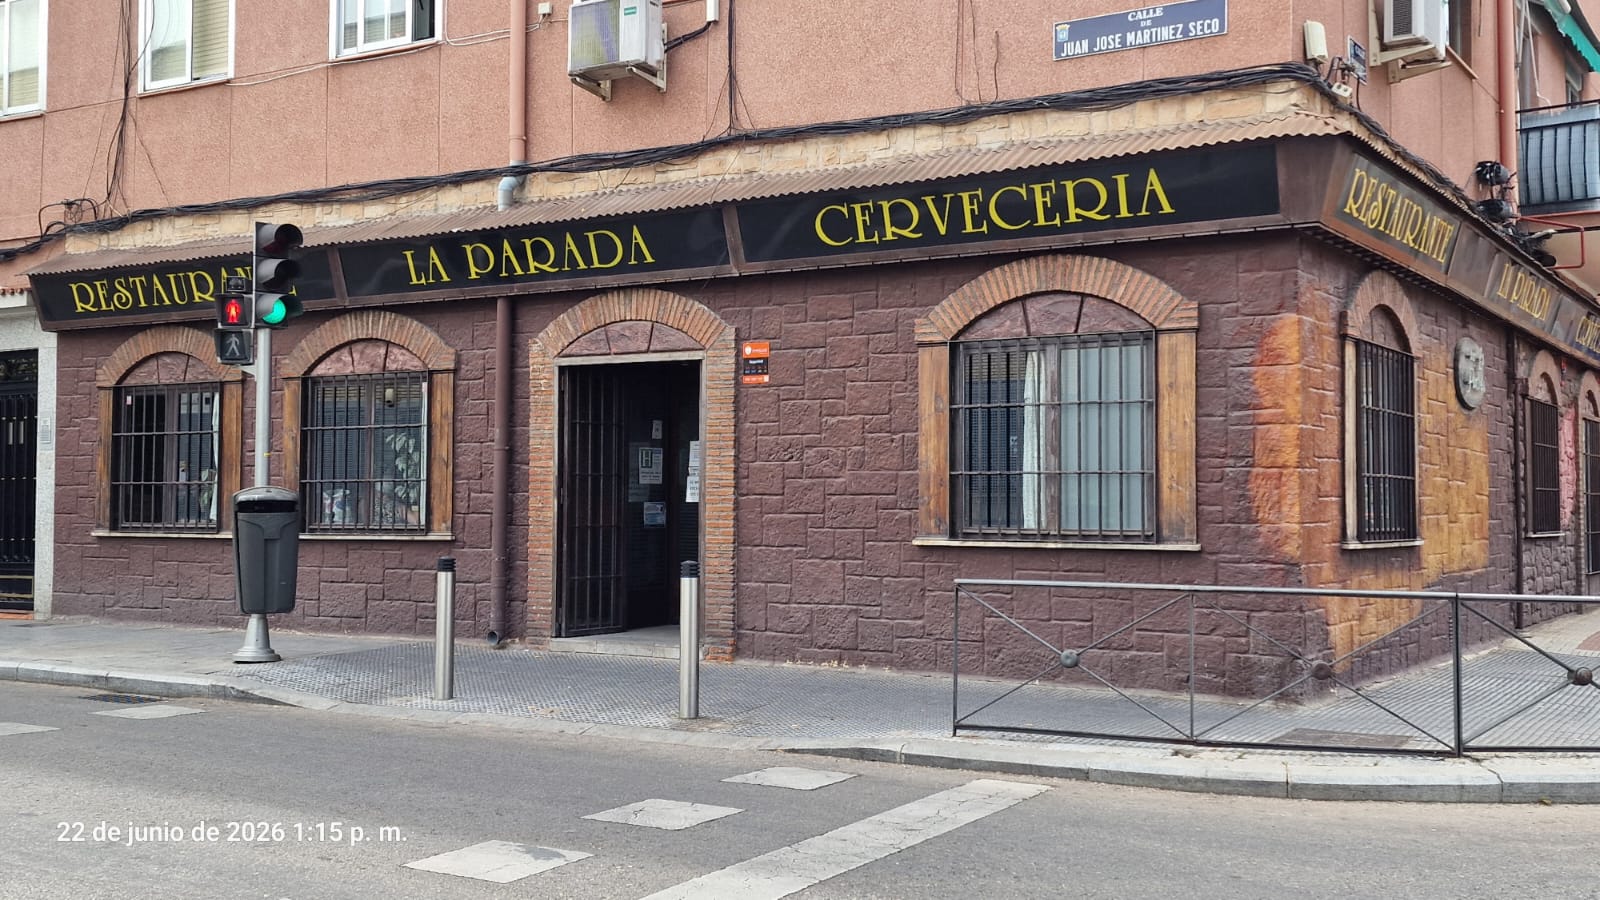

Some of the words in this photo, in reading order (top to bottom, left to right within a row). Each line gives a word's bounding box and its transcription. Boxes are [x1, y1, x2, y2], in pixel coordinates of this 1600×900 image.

[1060, 38, 1089, 57] JUAN
[1093, 33, 1123, 52] JOSE
[1126, 23, 1184, 46] MARTINEZ
[1188, 18, 1220, 37] SECO
[1127, 7, 1164, 22] CALLE
[814, 167, 1176, 247] CERVECERIA
[1343, 168, 1455, 263] RESTAURANTE
[402, 245, 451, 286] LA
[461, 225, 656, 280] PARADA
[1496, 262, 1512, 299] LA
[1508, 271, 1551, 321] PARADA
